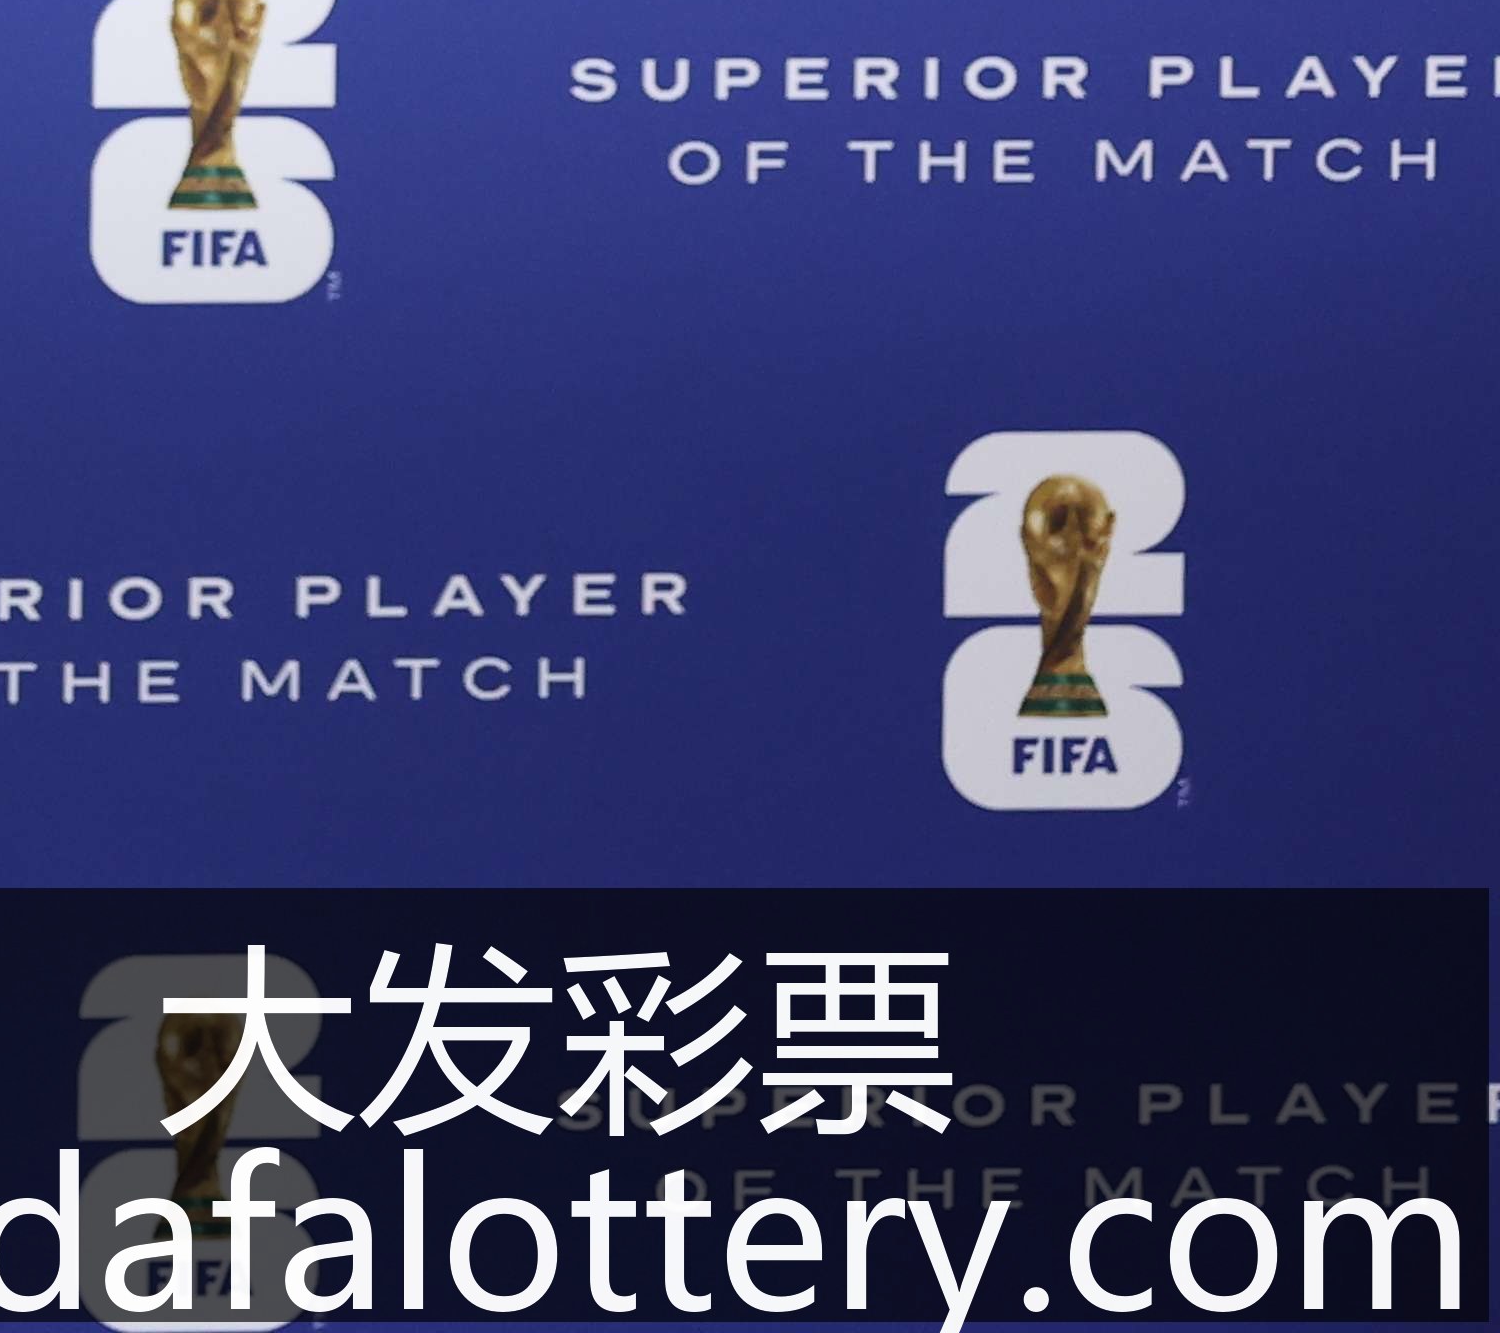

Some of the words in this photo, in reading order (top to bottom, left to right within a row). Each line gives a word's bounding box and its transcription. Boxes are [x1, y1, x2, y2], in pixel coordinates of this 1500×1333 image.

[569, 55, 1089, 103] SUPERIOR
[1150, 55, 1500, 99] PLAYE
[668, 140, 789, 186] OF
[846, 139, 1035, 183] THE
[1095, 138, 1436, 182] MATCH
[162, 229, 268, 267] FIFA
[296, 572, 687, 618] PLAYER
[241, 657, 585, 702] MATCH
[1015, 739, 1116, 774] FIFA
[835, 1167, 1024, 1210] THE
[1084, 1164, 1432, 1206] MATCH
